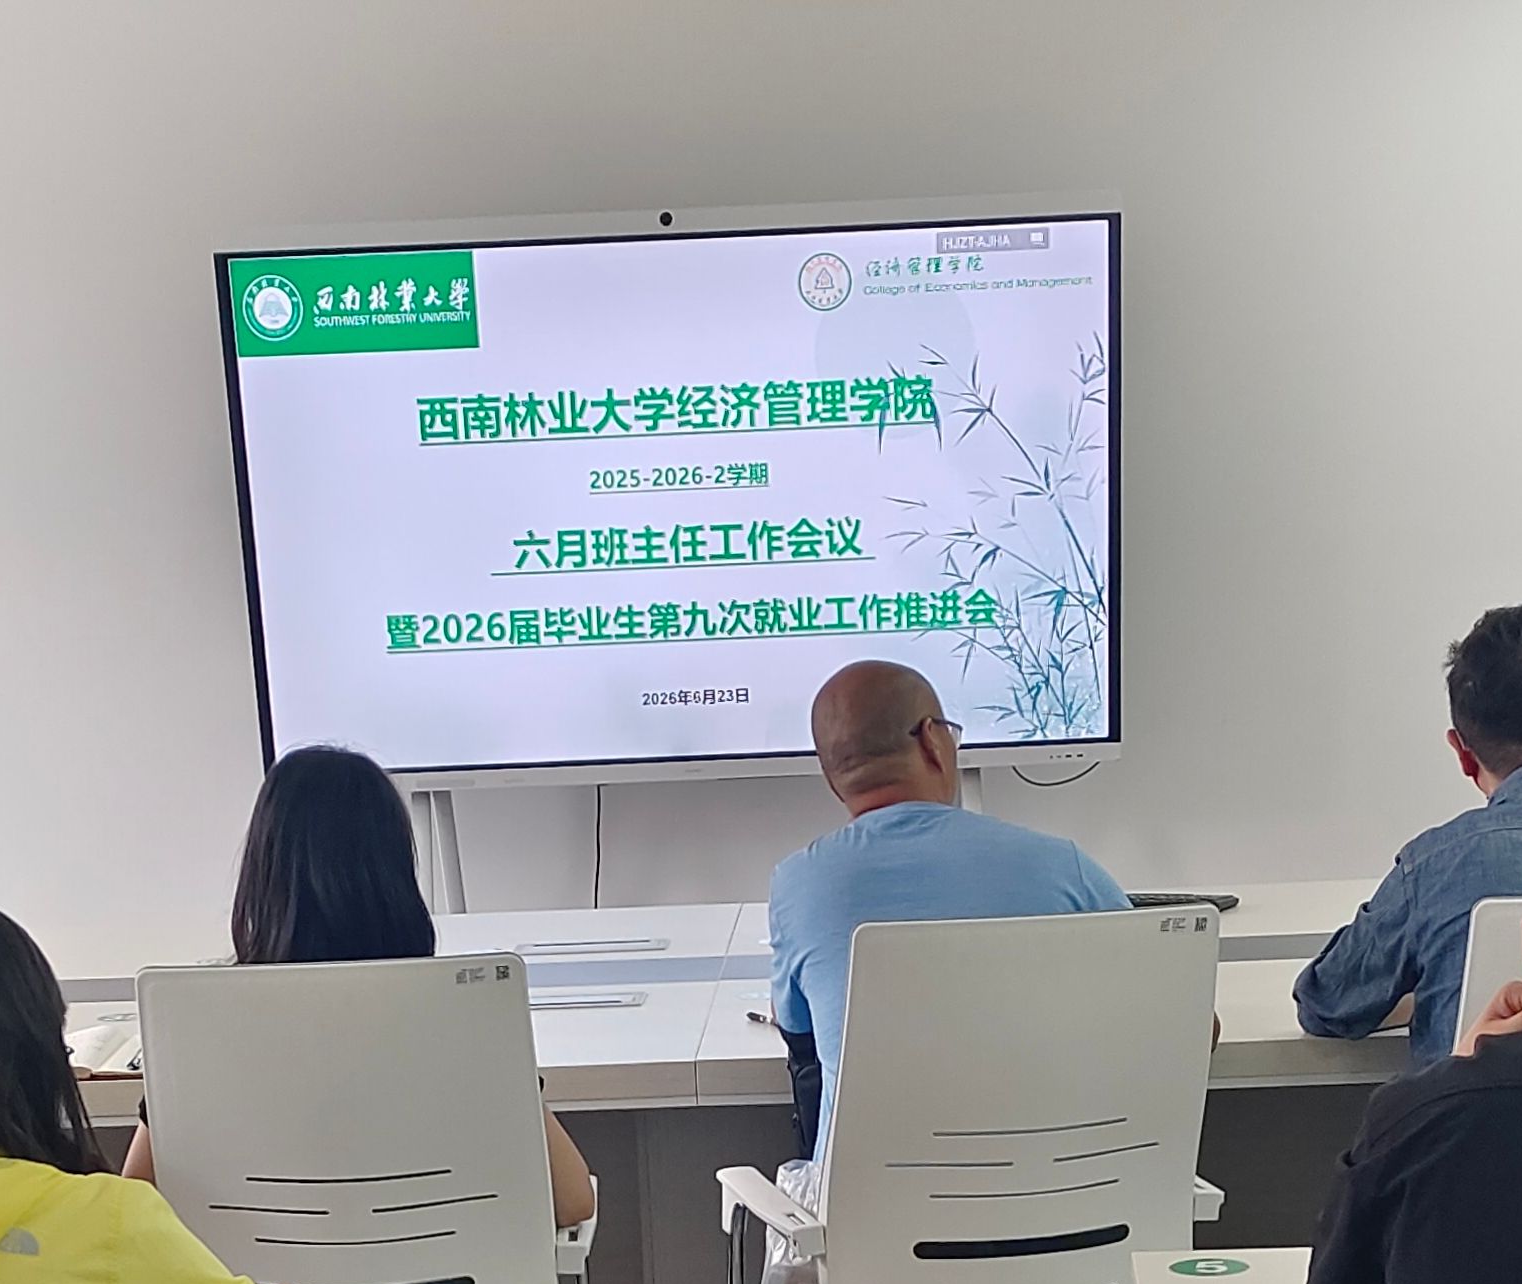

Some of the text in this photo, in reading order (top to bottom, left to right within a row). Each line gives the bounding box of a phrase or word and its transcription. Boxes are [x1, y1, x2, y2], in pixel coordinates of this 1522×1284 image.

[863, 276, 1093, 296] College of Economics and Management
[313, 311, 472, 328] SOUTHWEST FORESTRY UNIVERSITY
[416, 375, 936, 442] 西南林业大学经济管理学院
[589, 462, 769, 491] 2025-2026-2学期
[513, 517, 863, 570] 六月班主任工作会议
[386, 588, 1001, 651] 暨2026届毕业生第九次就业工作推进会
[642, 687, 750, 707] 2026年6月23日
[1195, 1260, 1228, 1274] 5
